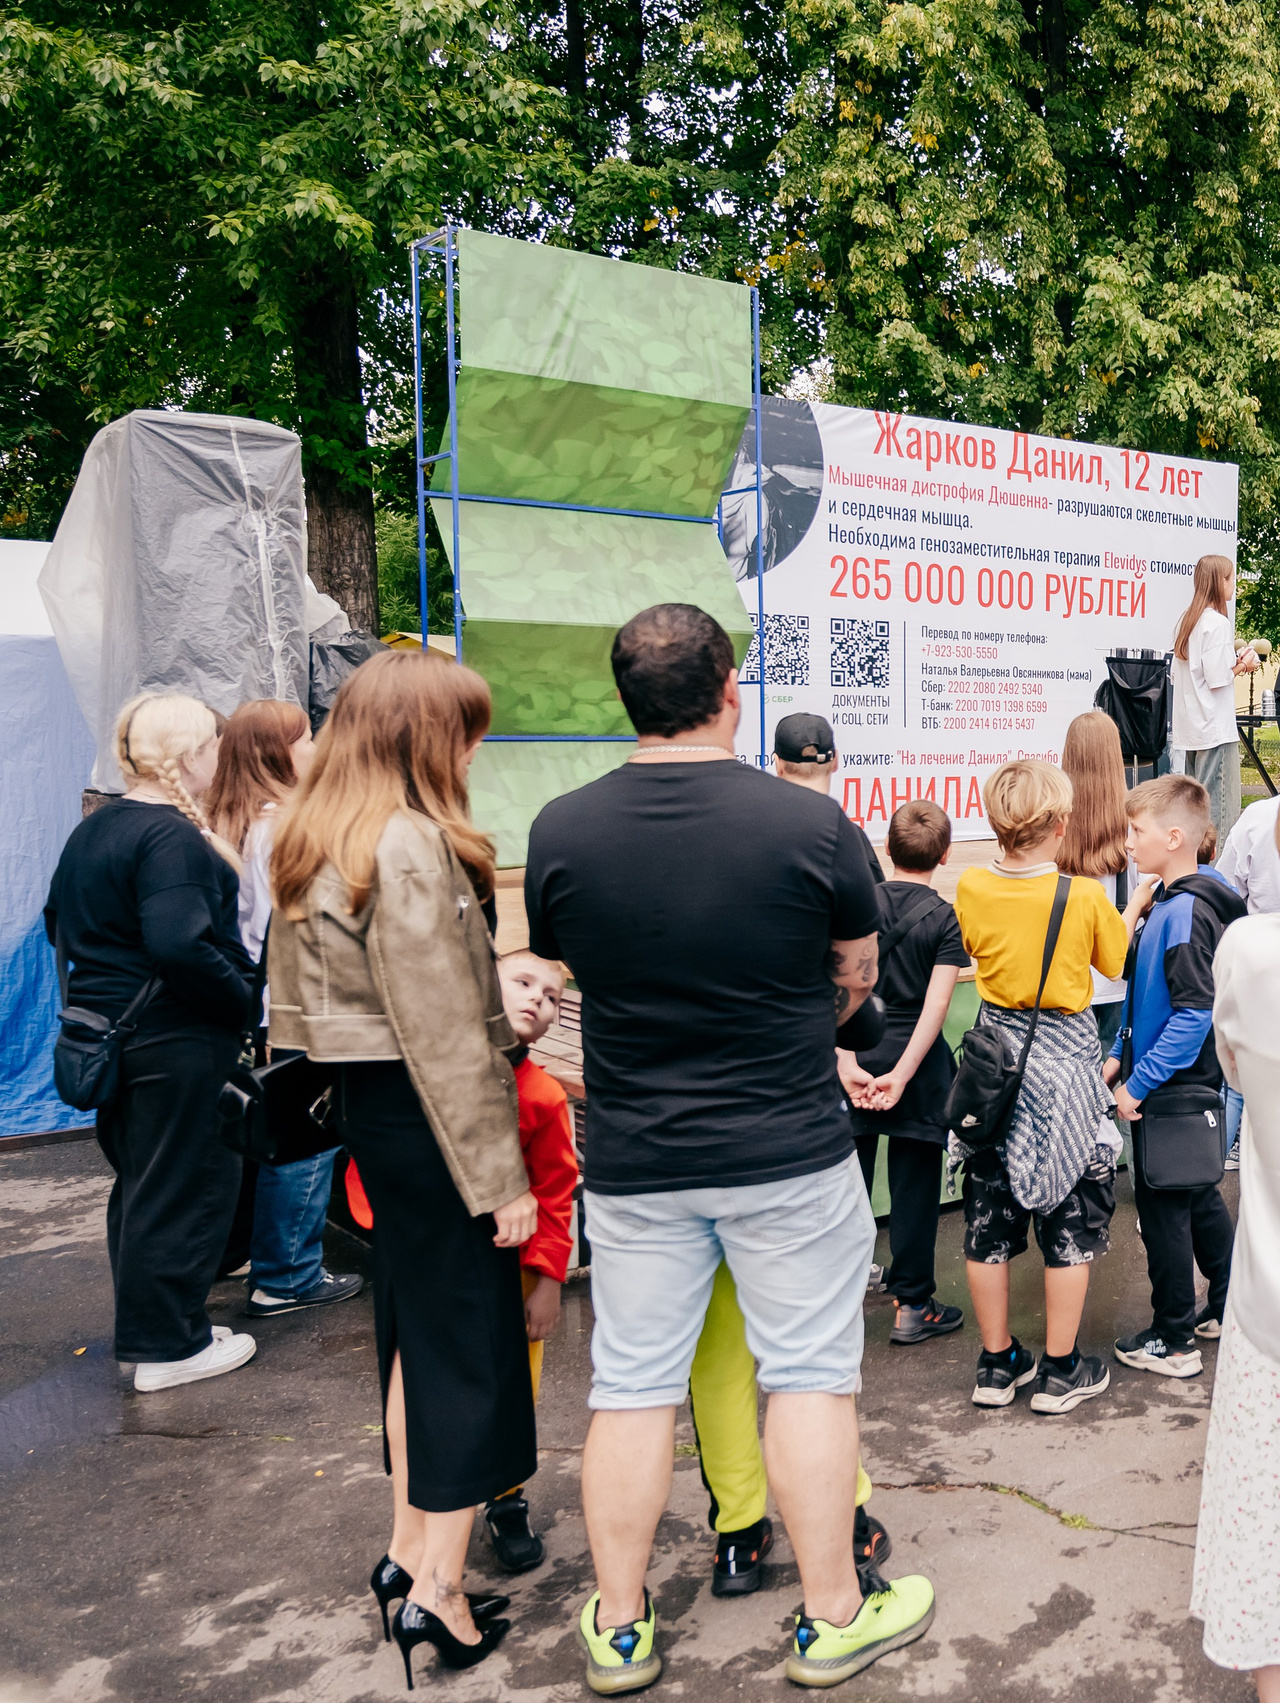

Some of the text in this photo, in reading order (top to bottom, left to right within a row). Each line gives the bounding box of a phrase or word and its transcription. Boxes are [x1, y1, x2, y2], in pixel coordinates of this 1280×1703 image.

[873, 410, 1203, 498] Жарков Данил, 12 лет
[828, 464, 907, 493] Мышечная
[911, 480, 984, 504] дистрофия
[1057, 498, 1133, 520] разрушаются
[1136, 507, 1194, 528] скелетные
[1196, 516, 1236, 534] мышцы
[828, 499, 973, 531] и сердечная мышца.
[828, 523, 1197, 577] Необходима генозаместительная терапия Elevidys стоимос
[829, 554, 1146, 619] 265 000 000 РУБЛЕЙ
[921, 625, 1048, 645] Перевод по номеру телефона:
[921, 644, 998, 659] +7-923-530-5550
[921, 662, 1092, 682] Наталья Валерьевна Овсянникова (мама)
[921, 679, 1043, 695] Сбер: 2202 2080 2492 5340
[771, 695, 793, 703] СБЕР
[832, 694, 890, 708] ДОКУМЕНТЫ
[921, 699, 1048, 713] Т-банк: 2200 7019 1398 6599
[832, 712, 889, 727] И СОЦ. СЕТИ
[921, 717, 1035, 730] ВТБ: 2200 2414 6124 5437
[842, 752, 894, 767] укажите:
[896, 750, 916, 765] "На
[919, 753, 965, 765] лечение
